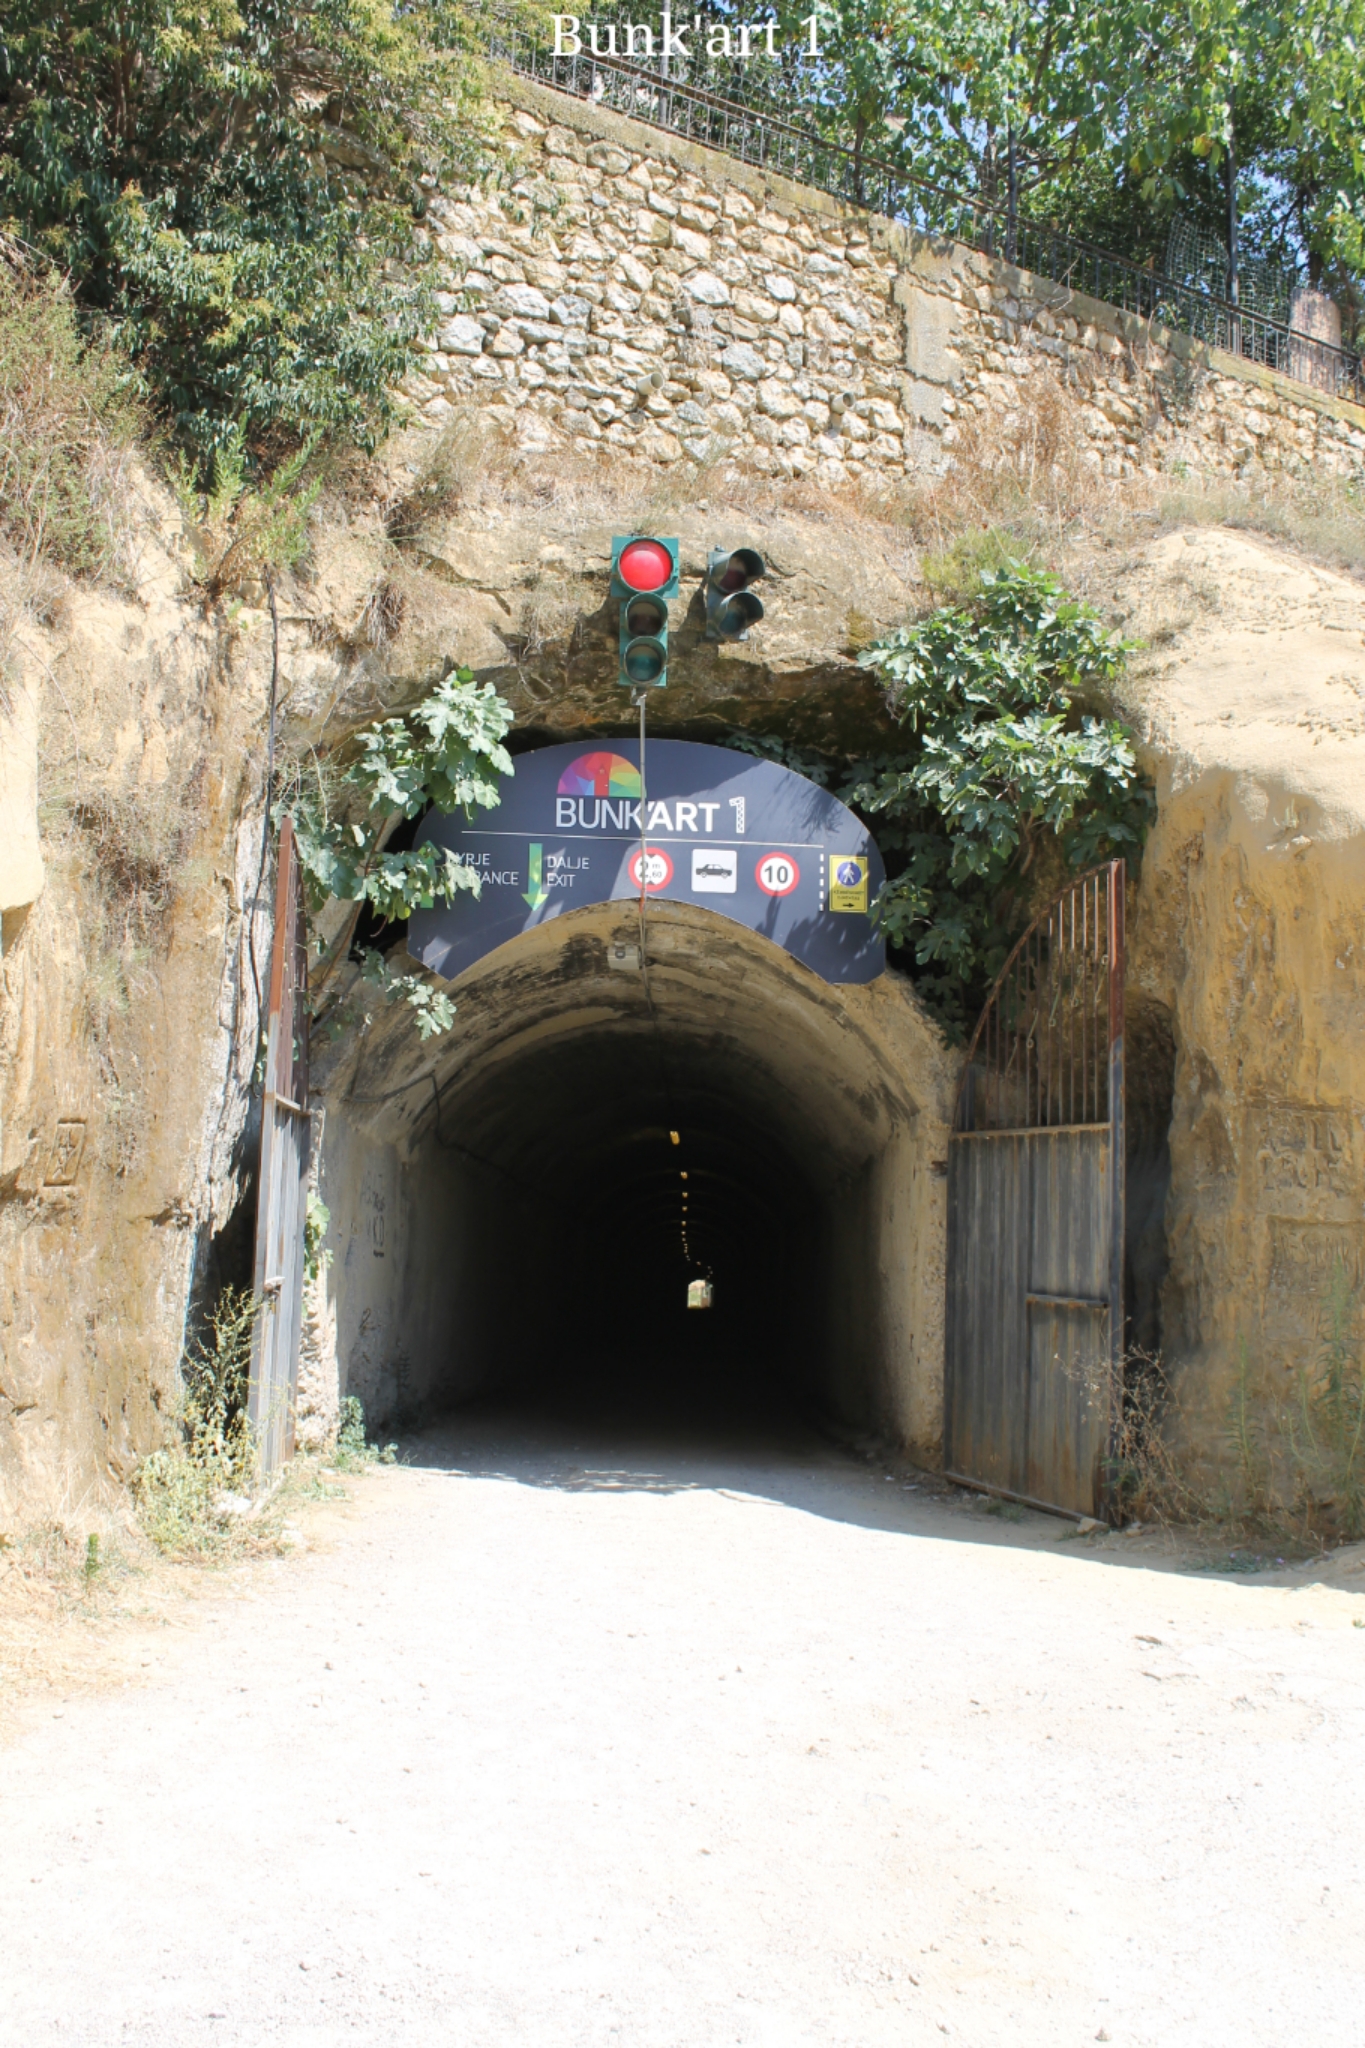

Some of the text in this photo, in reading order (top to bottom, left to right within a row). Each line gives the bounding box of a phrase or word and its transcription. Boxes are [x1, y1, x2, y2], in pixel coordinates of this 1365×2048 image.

[556, 796, 745, 833] BUNK'ART 1
[455, 852, 491, 866] YRJE
[547, 855, 590, 869] DALJE
[547, 872, 575, 887] EXIT
[764, 865, 789, 884] 10
